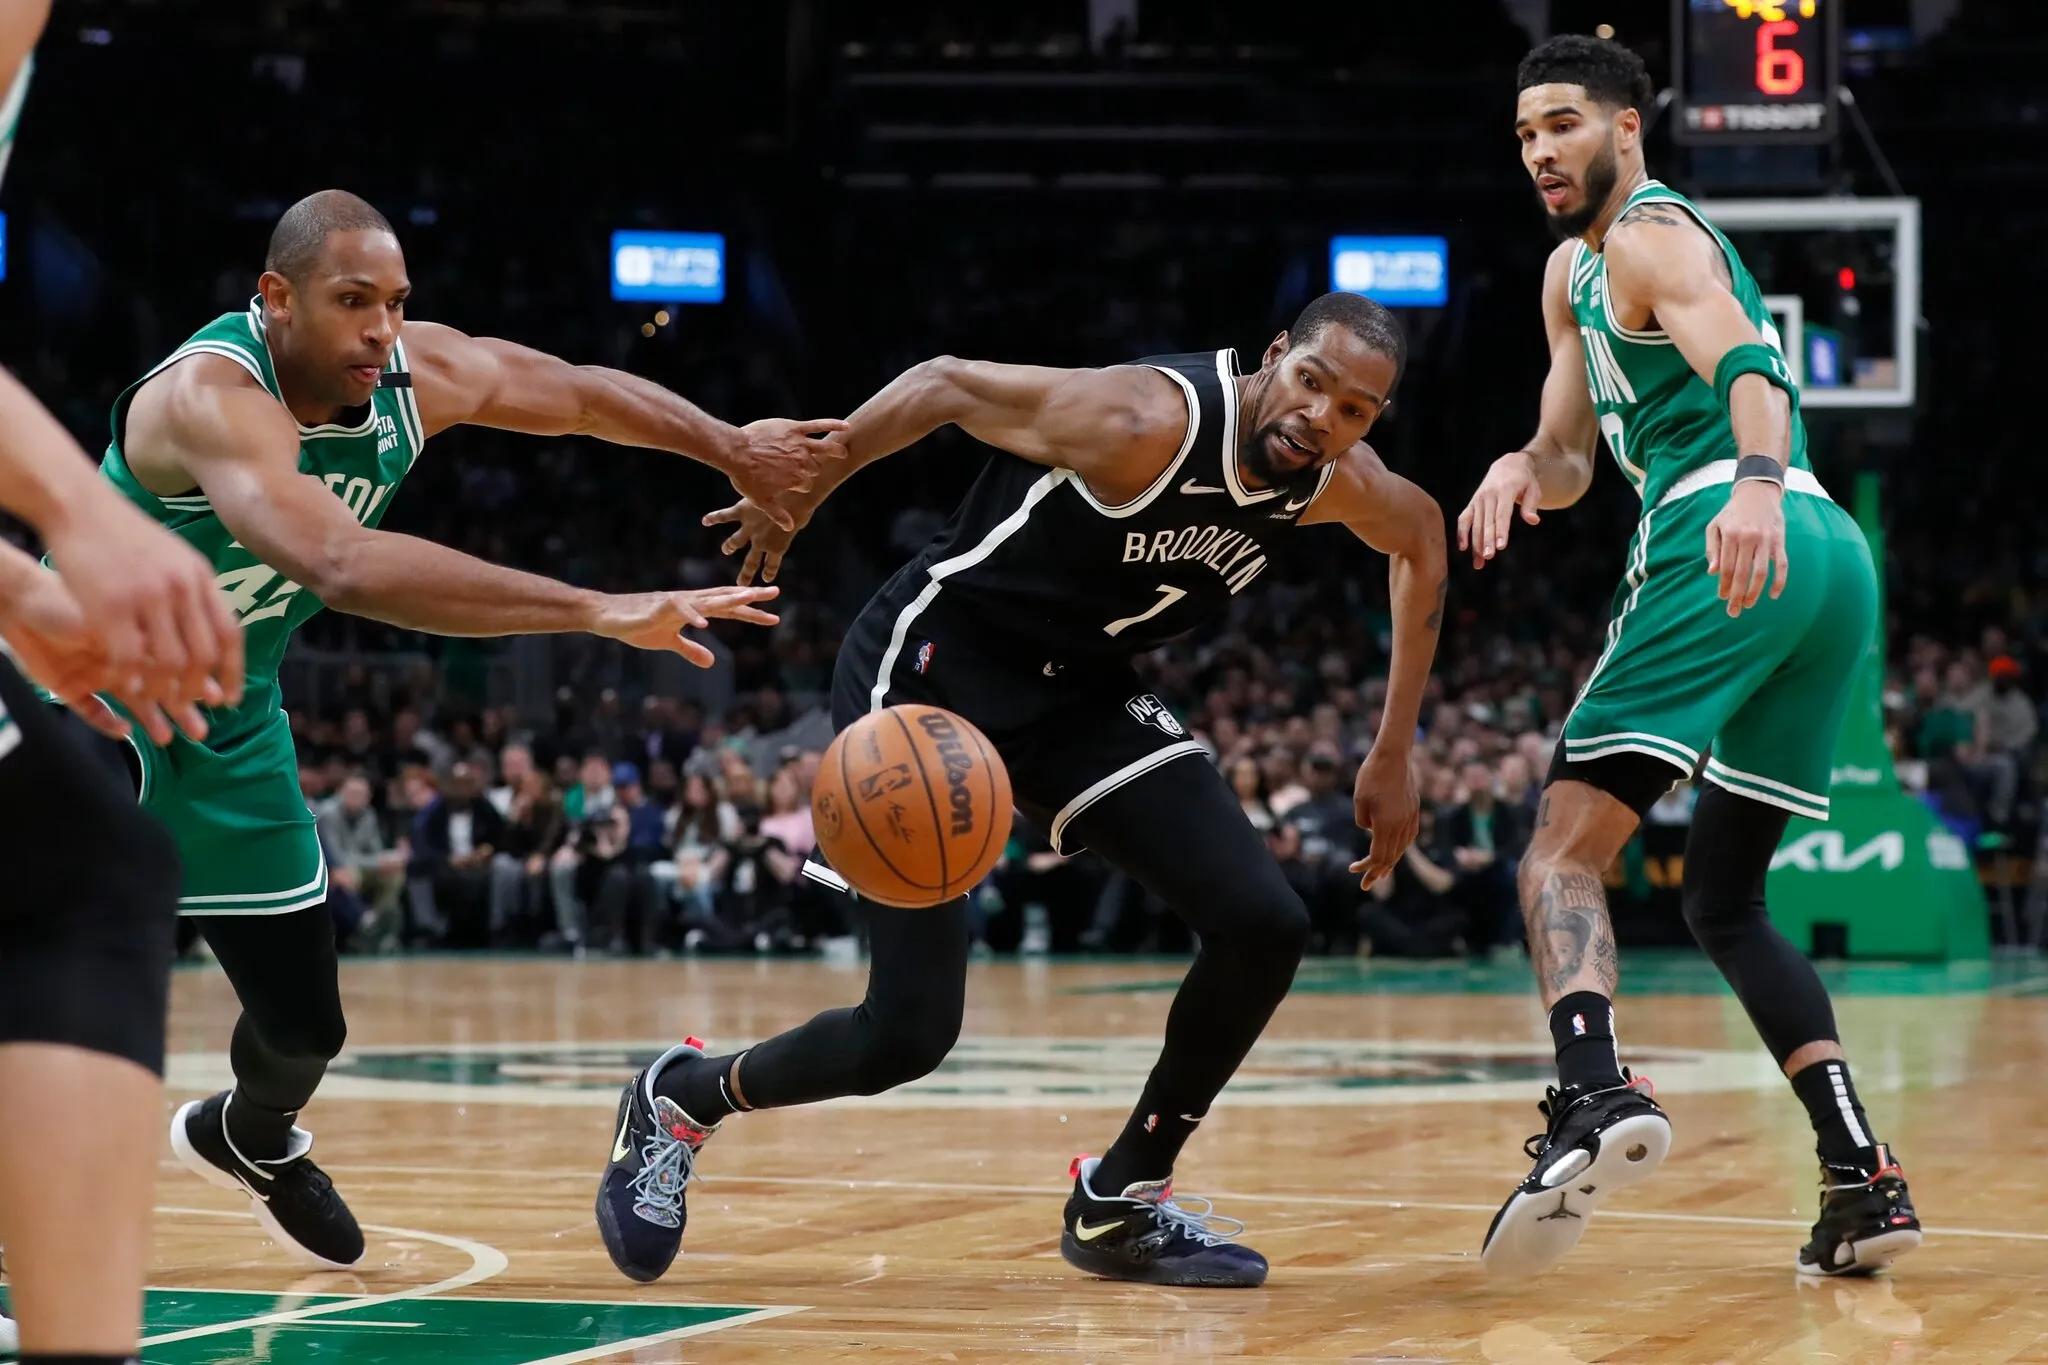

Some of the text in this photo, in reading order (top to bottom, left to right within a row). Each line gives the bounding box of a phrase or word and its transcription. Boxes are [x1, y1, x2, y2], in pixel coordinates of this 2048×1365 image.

[1756, 19, 1803, 95] 6
[211, 563, 303, 628] 42
[1122, 525, 1268, 596] BROOKLYN
[1103, 583, 1188, 638] 7
[917, 712, 974, 838] Wilson
